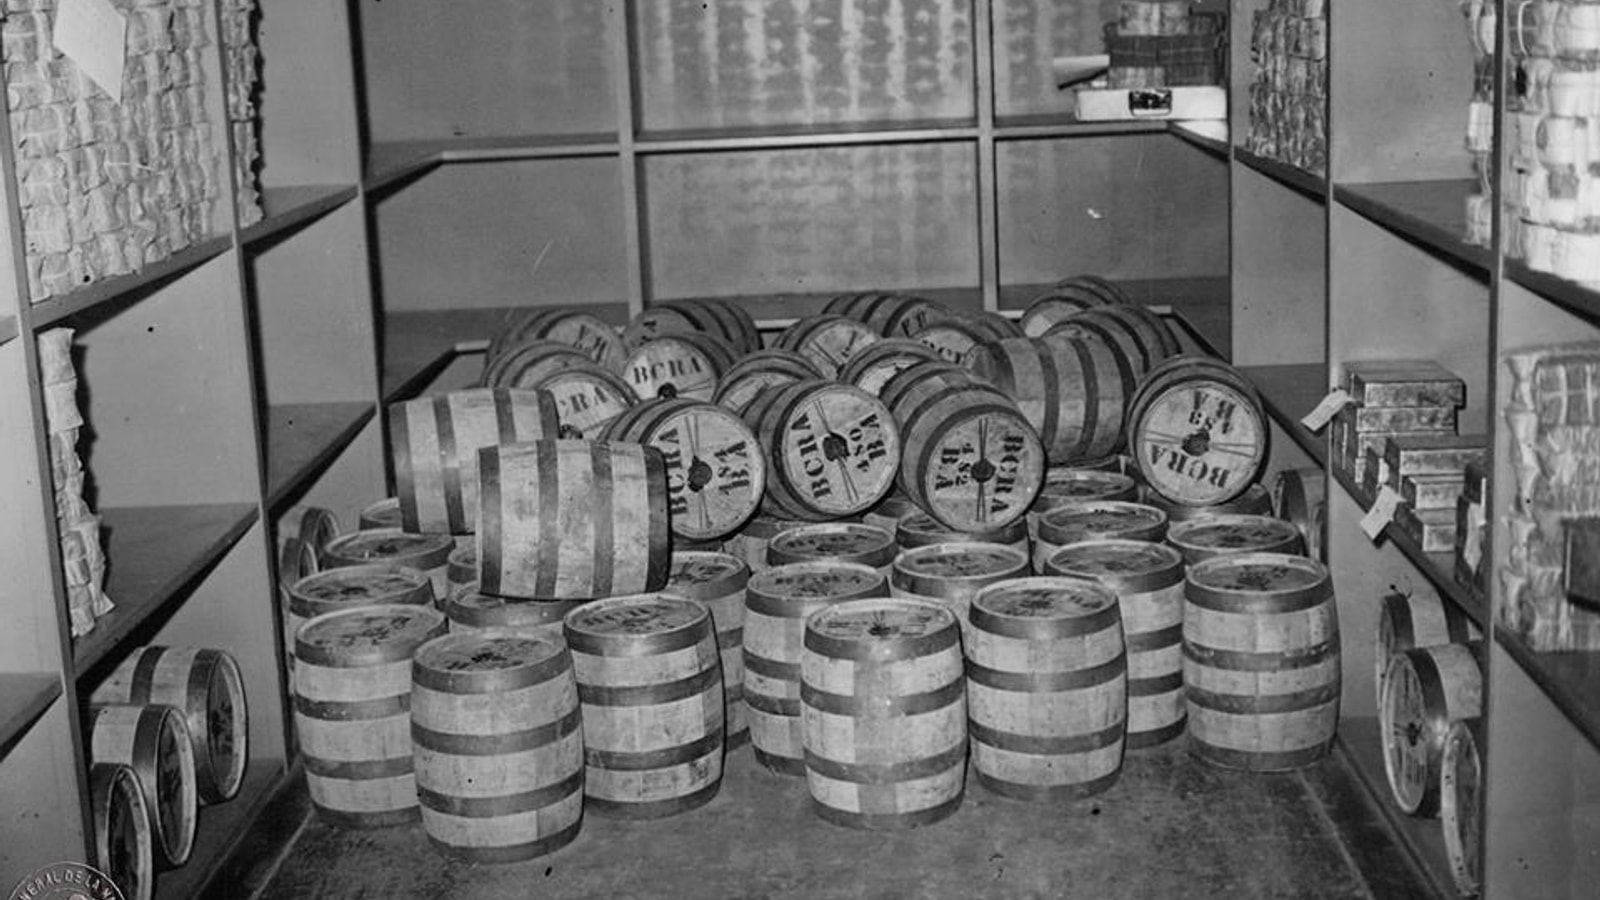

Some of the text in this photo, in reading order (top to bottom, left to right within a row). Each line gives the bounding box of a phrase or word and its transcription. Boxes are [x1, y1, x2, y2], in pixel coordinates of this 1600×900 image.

[791, 412, 832, 499] BCRA
[990, 435, 1025, 514] BCRA
[1151, 444, 1231, 489] BCRA
